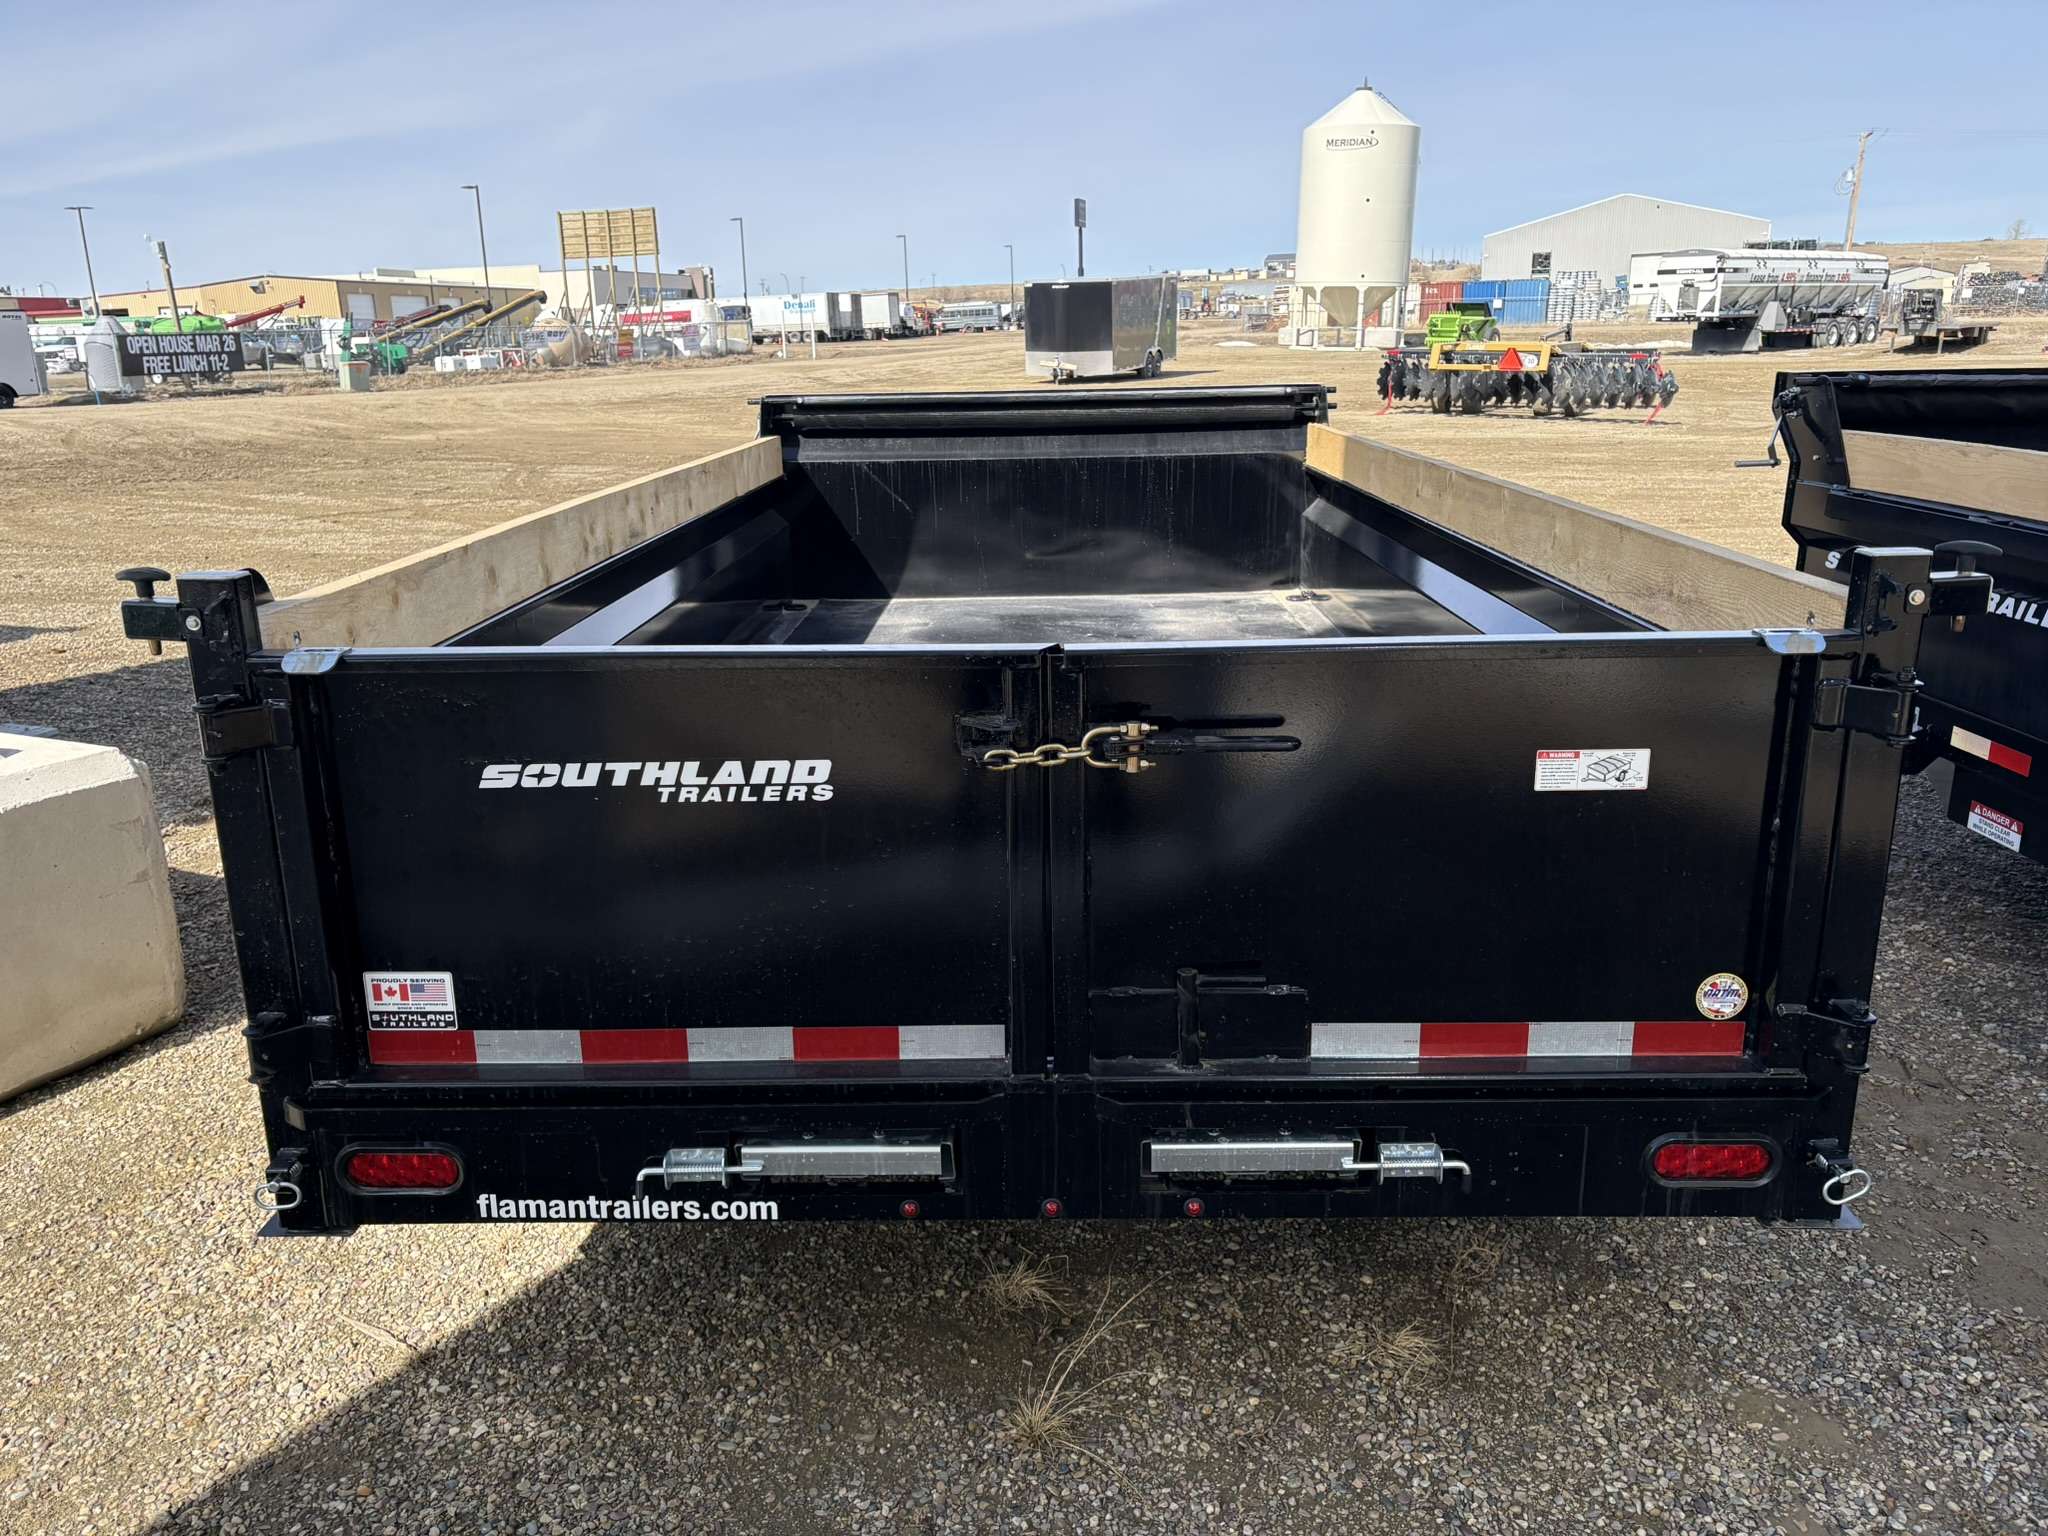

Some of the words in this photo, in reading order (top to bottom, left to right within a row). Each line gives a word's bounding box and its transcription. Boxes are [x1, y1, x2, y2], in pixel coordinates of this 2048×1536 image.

[1326, 138, 1373, 147] MERIDIAN
[784, 299, 816, 310] Denali
[126, 336, 158, 354] OPEN
[158, 335, 194, 353] HOUSE
[195, 335, 220, 352] MAR
[223, 335, 236, 351] 26
[142, 355, 172, 374] FREE
[172, 355, 208, 373] LUNCH
[209, 354, 230, 371] 11-2
[478, 759, 832, 789] SOUTHLAND
[658, 784, 834, 803] TRAILERS
[1982, 808, 2010, 827] DANGER
[1987, 830, 2014, 847] OPERATING
[1994, 826, 2011, 837] CLEAR
[476, 1194, 778, 1220] flamantrailers.com
